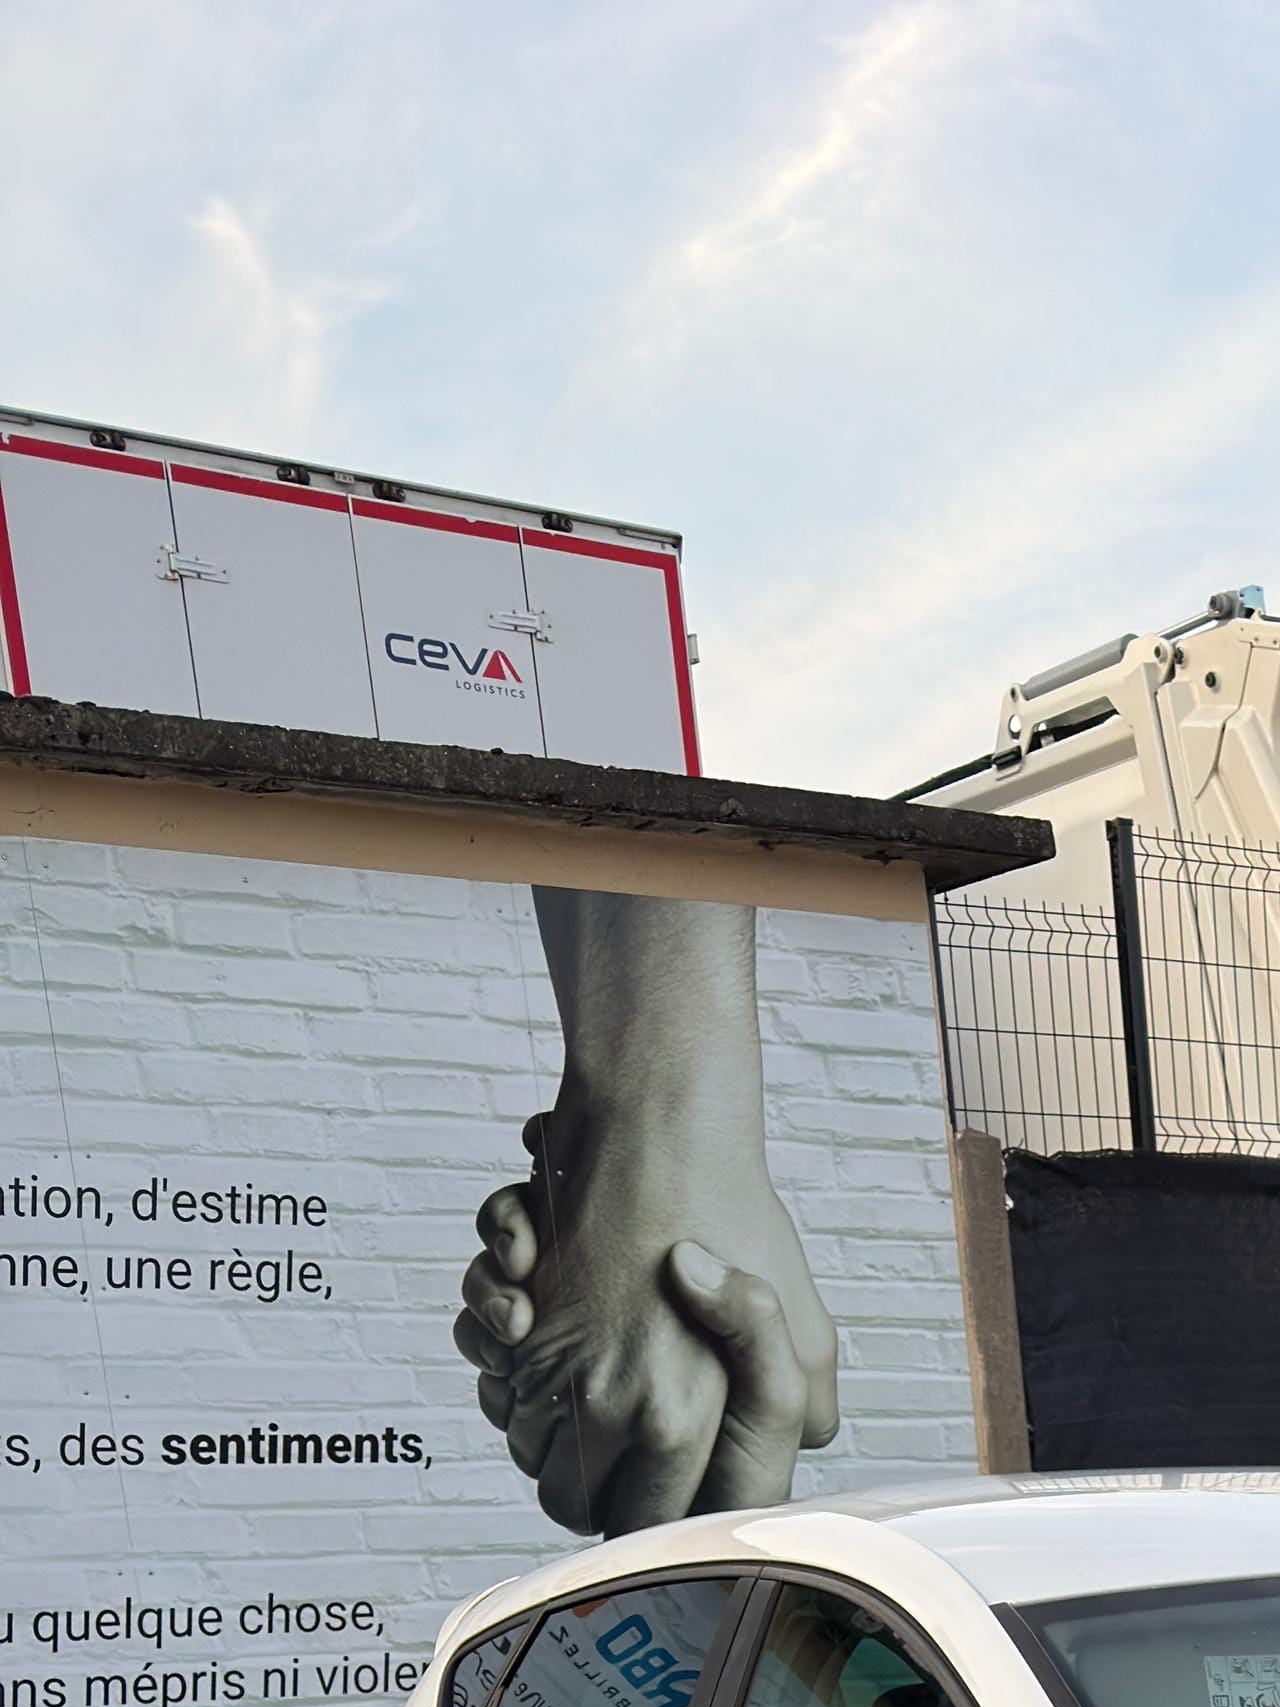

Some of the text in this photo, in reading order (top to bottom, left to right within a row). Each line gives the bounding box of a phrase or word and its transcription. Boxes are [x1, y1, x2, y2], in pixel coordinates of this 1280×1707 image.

[455, 679, 526, 699] LOGISTICS
[131, 1177, 327, 1226] d'estime
[106, 1256, 192, 1290] une
[209, 1248, 333, 1303] règle,
[60, 1422, 145, 1466] des
[161, 1423, 432, 1470] sentiments,
[32, 1597, 223, 1653] quelque
[239, 1593, 384, 1637] chose,
[263, 1657, 299, 1698] ni
[316, 1652, 432, 1696] viole
